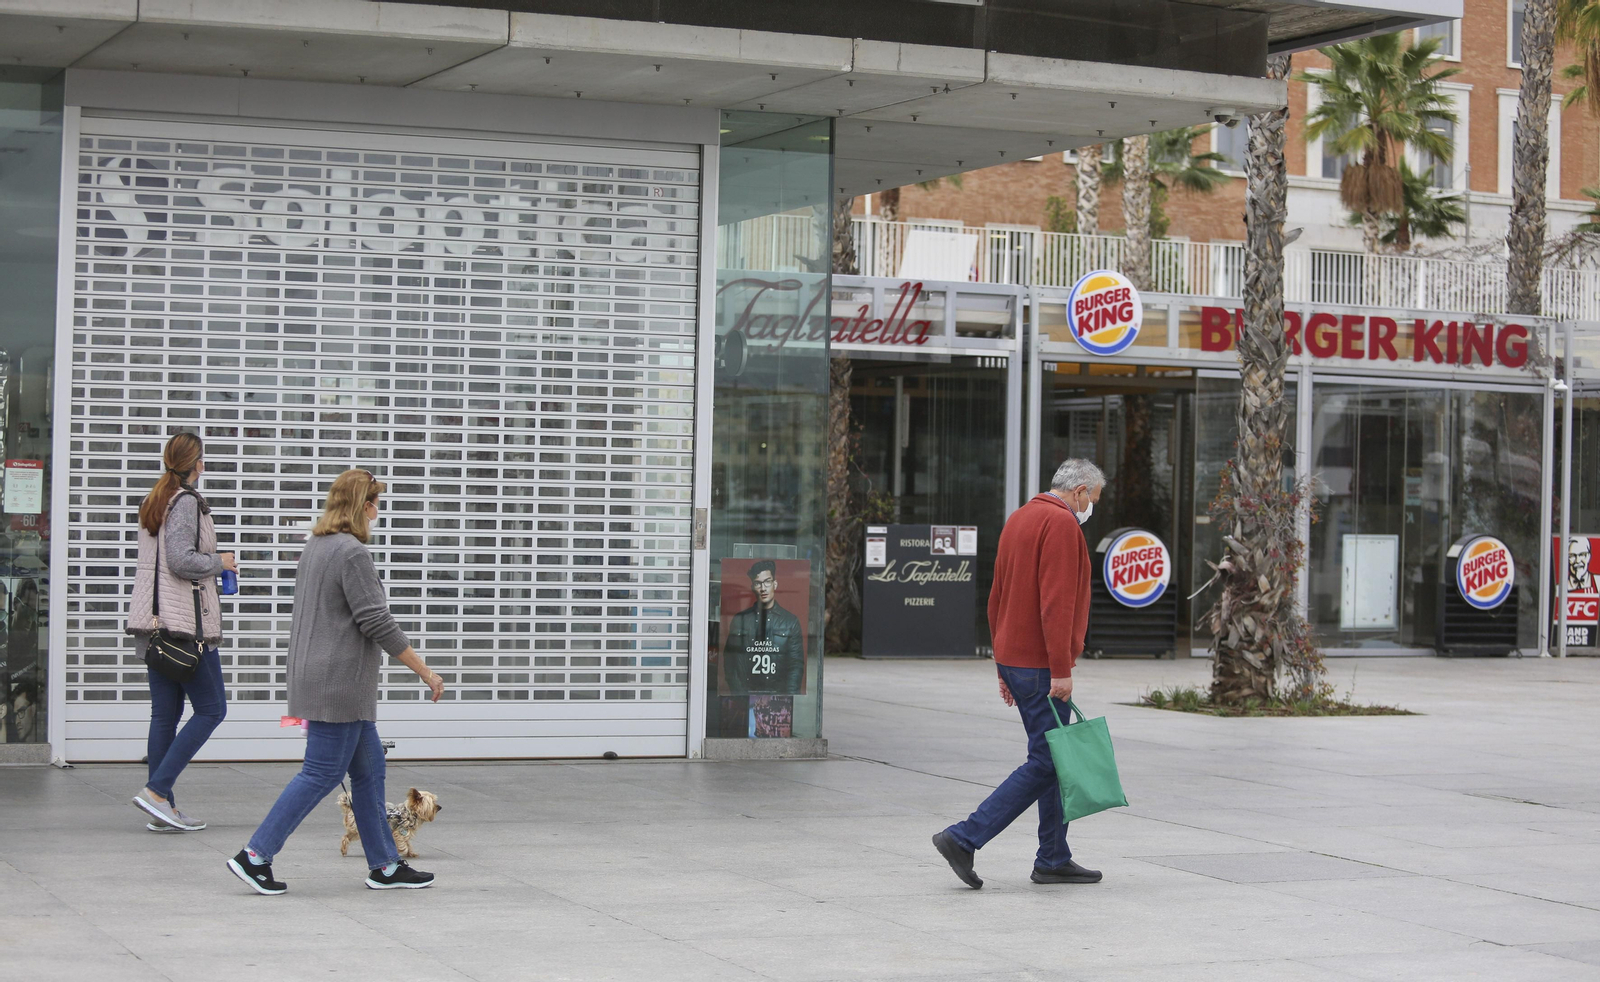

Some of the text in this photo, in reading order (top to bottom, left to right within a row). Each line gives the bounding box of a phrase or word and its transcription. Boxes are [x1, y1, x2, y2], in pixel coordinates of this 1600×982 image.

[716, 277, 932, 352] Tagliatella
[1075, 287, 1131, 316] BURGER
[1078, 302, 1133, 337] KING
[1201, 306, 1528, 368] BRGER KING
[867, 559, 972, 585] La Tagliatella
[1111, 547, 1162, 569] BURGER
[1463, 549, 1506, 577] BURGER
[1112, 559, 1164, 589] KING
[1465, 561, 1508, 594] KING
[904, 598, 935, 607] PIZZERIE
[1566, 627, 1589, 637] AND
[1566, 636, 1588, 645] ADE
[752, 654, 776, 674] 29€
